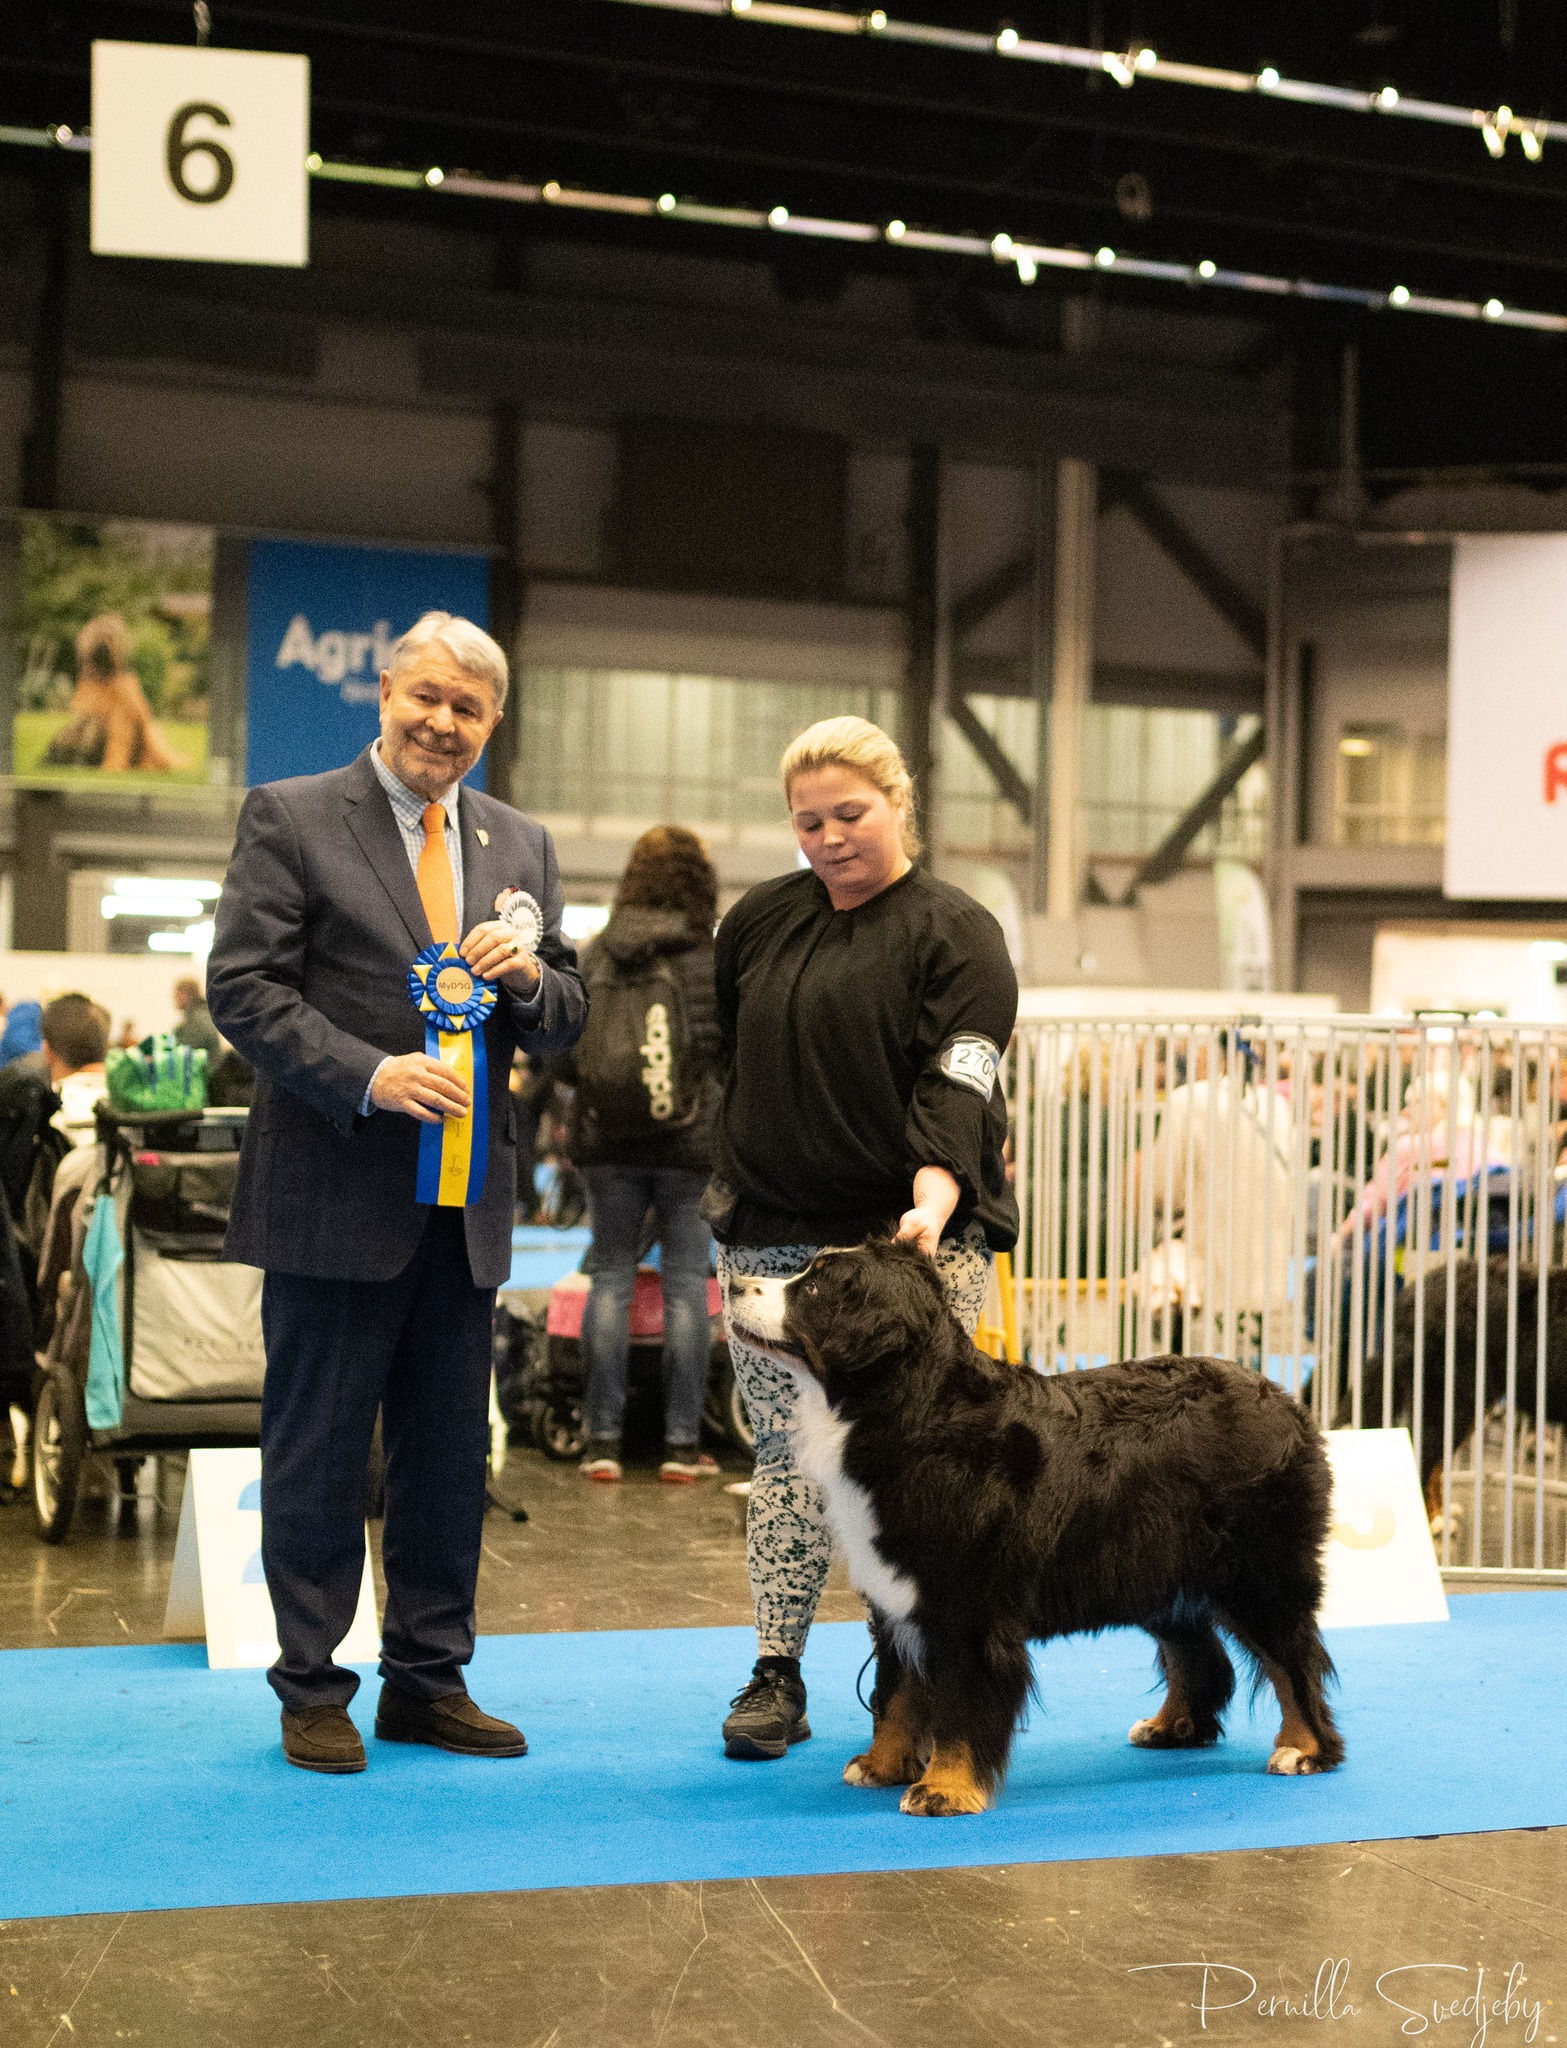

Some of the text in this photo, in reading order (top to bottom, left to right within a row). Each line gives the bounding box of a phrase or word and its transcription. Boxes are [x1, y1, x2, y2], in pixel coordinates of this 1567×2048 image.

[165, 102, 234, 204] 6
[640, 1003, 674, 1121] adidas
[957, 1048, 991, 1075] 270
